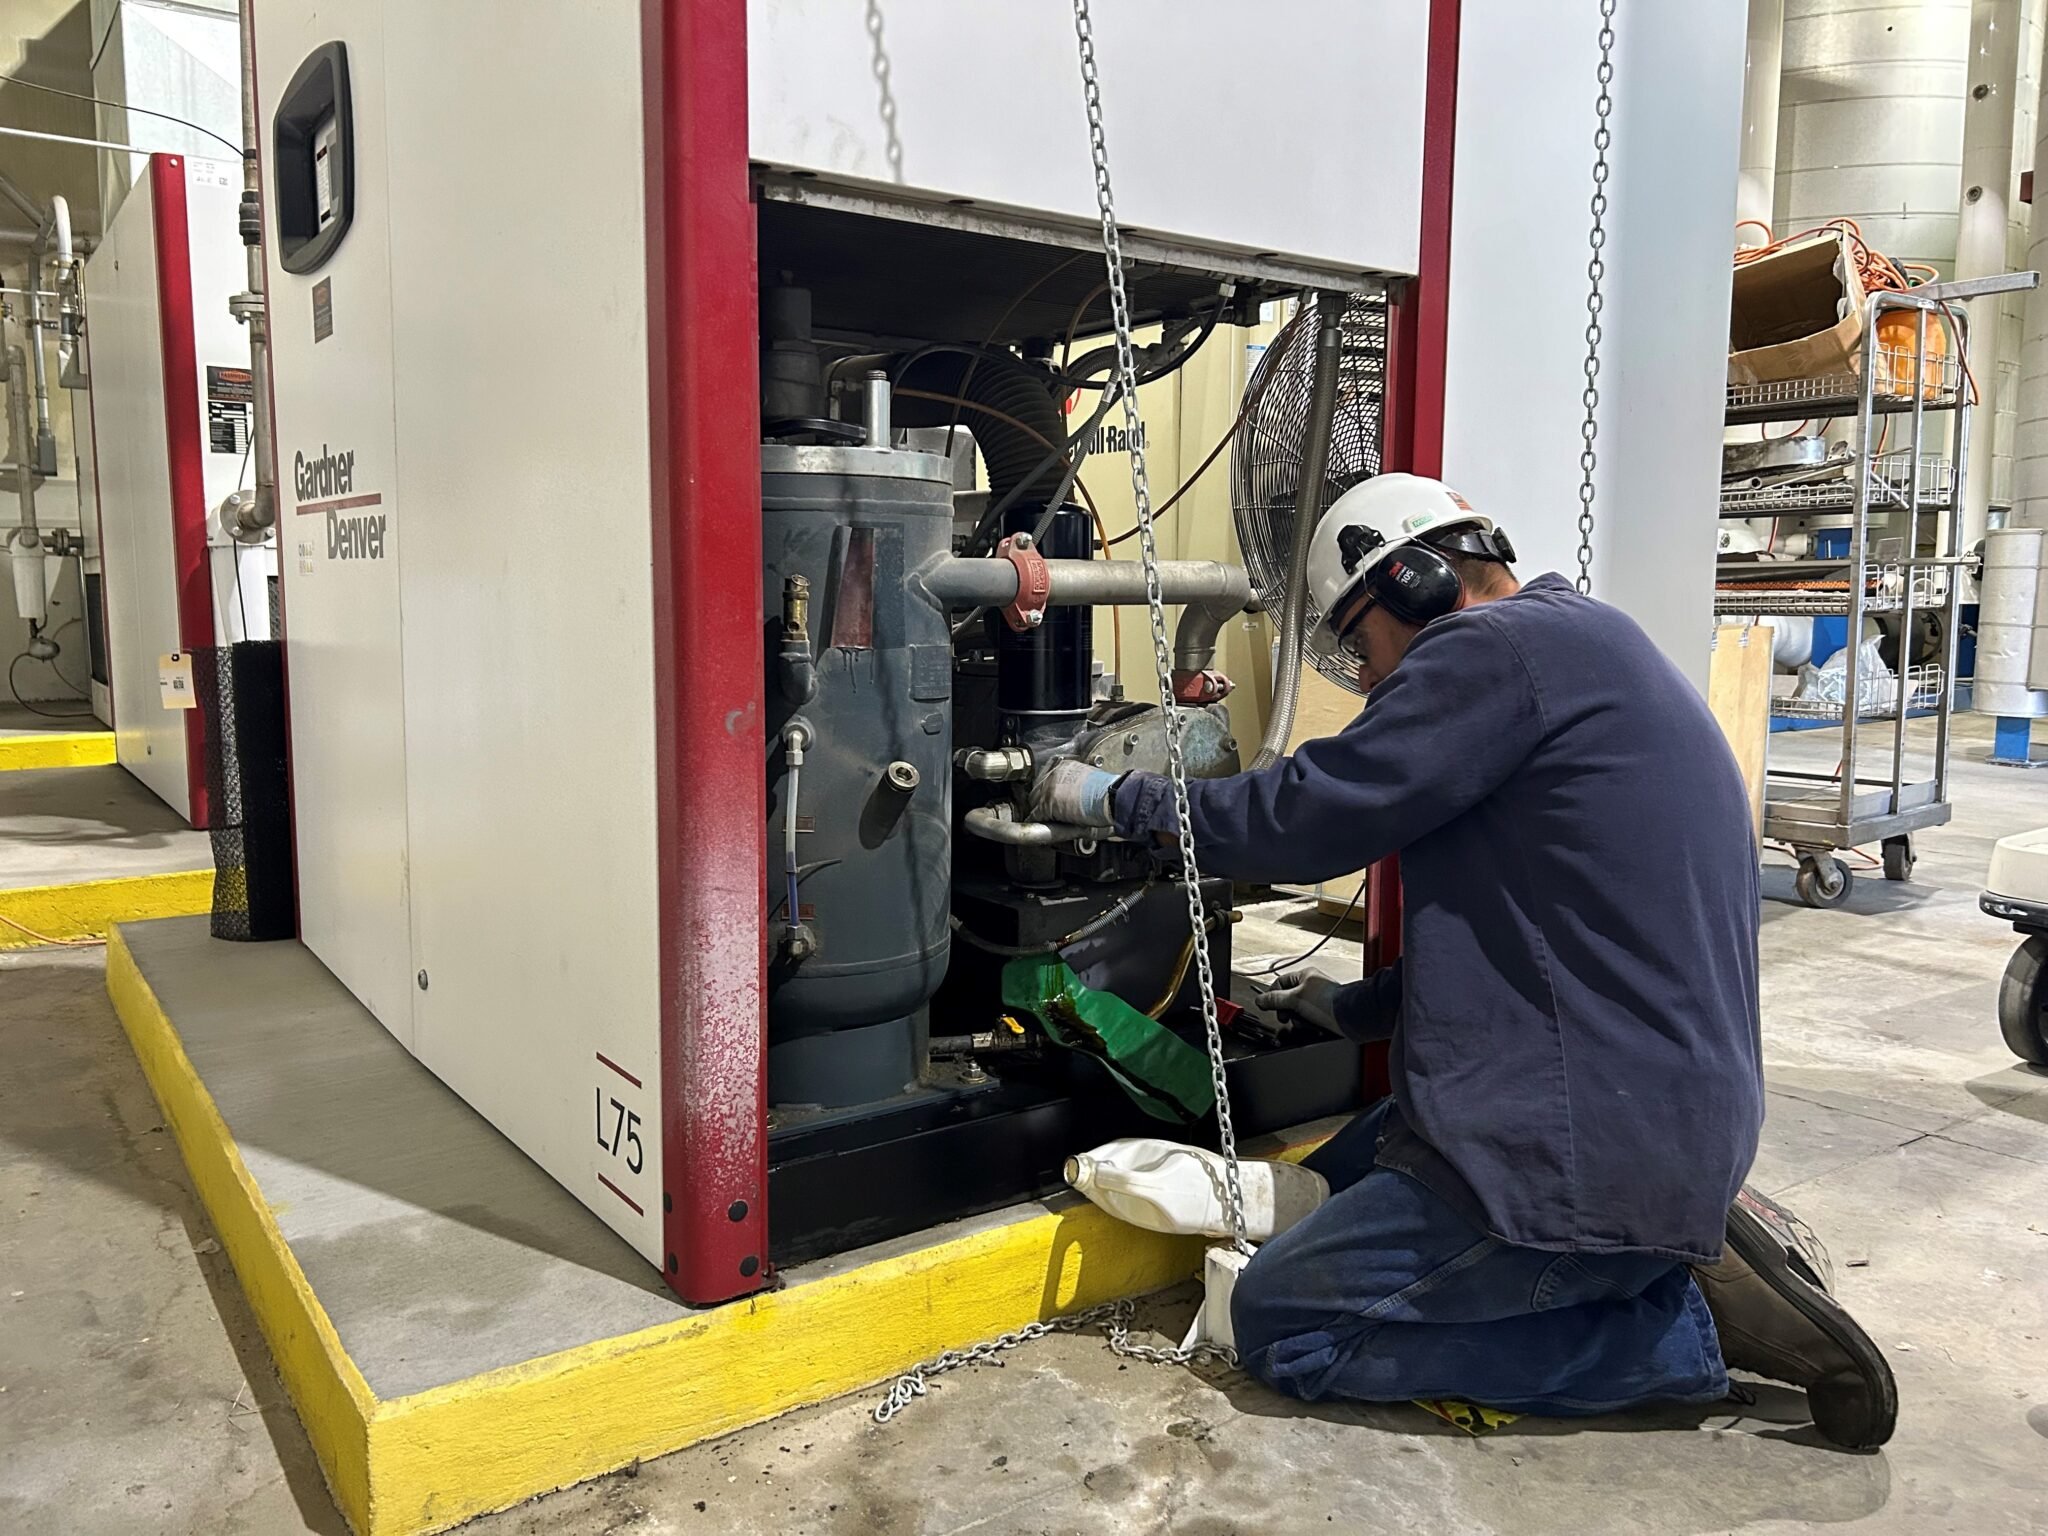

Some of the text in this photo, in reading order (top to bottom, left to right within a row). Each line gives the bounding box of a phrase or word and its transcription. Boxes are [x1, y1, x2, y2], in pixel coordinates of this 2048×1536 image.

[295, 443, 354, 502] Gardner
[326, 507, 386, 560] Denver
[1400, 570, 1414, 584] 105
[596, 1087, 643, 1175] L75
